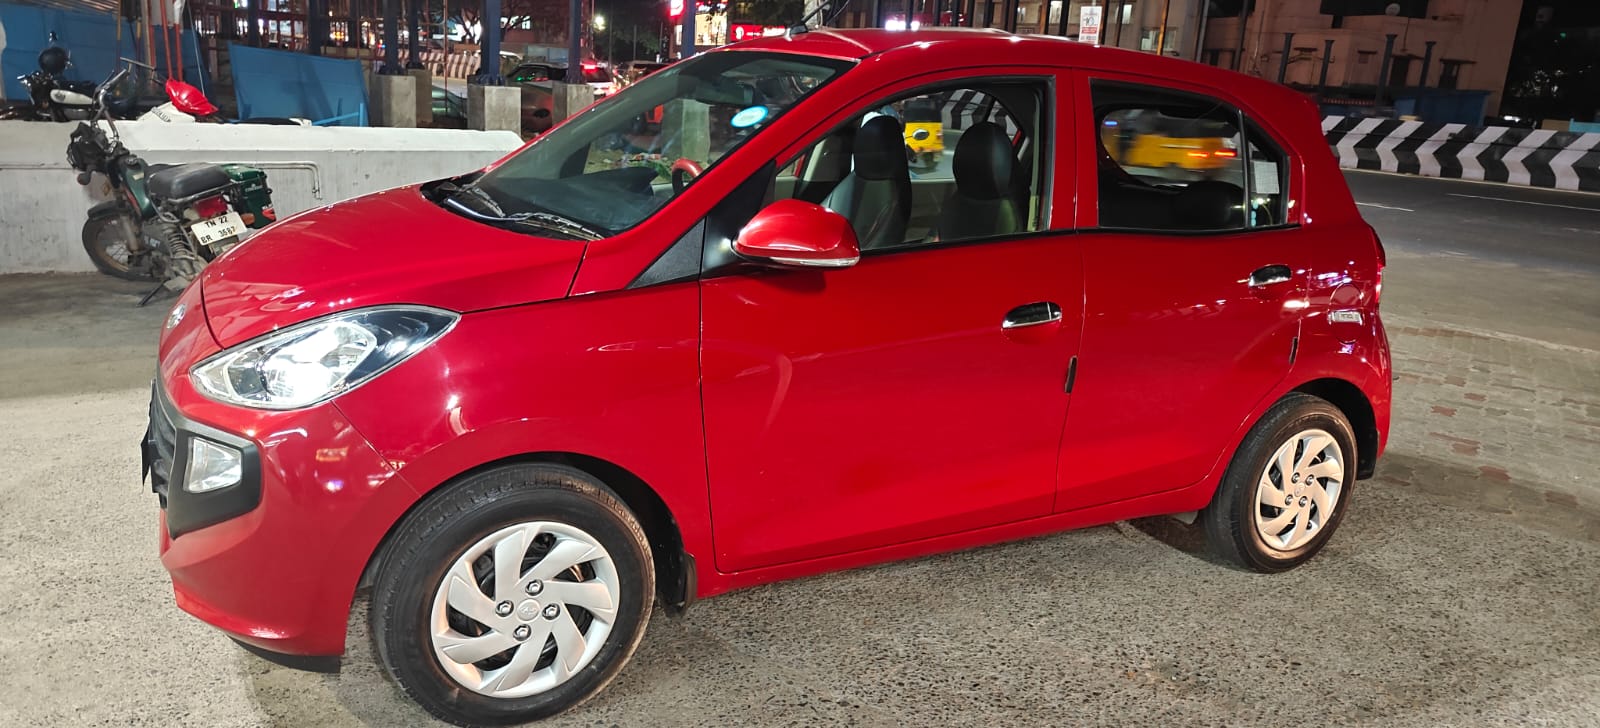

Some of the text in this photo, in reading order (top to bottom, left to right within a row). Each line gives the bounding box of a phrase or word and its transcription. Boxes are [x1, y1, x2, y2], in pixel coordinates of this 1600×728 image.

[204, 215, 228, 228] TN 22
[200, 234, 213, 243] BR
